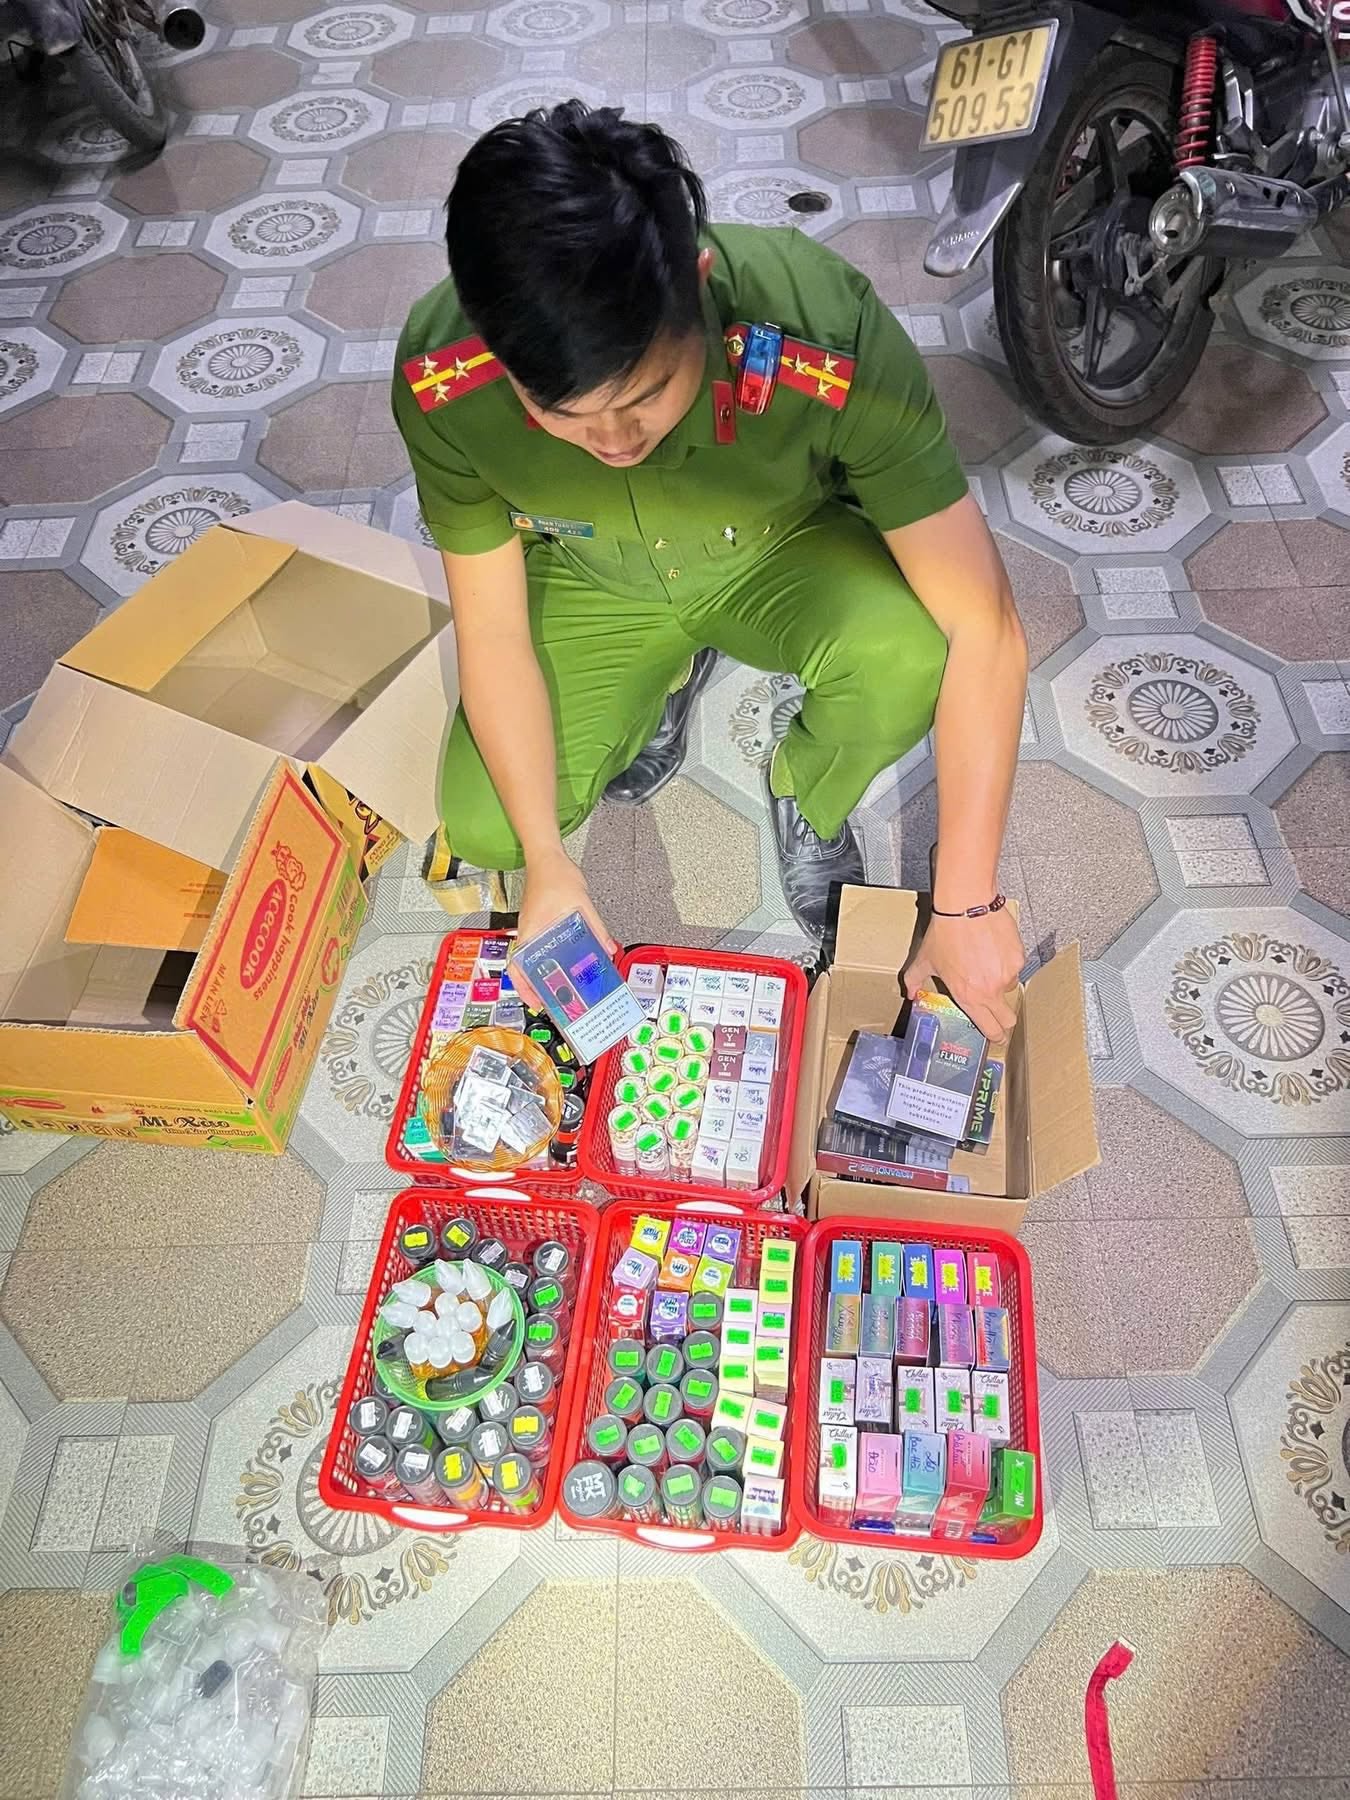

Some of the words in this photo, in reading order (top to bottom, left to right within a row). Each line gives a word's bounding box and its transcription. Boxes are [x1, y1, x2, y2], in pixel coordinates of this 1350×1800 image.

[950, 31, 1034, 89] 61-G1
[929, 82, 1035, 140] 509.53
[284, 893, 298, 934] Cook
[254, 935, 291, 1001] happiness
[726, 1033, 734, 1042] Y
[717, 1055, 736, 1064] GEN
[722, 1062, 730, 1071] Y
[940, 1051, 967, 1065] FLAVOR
